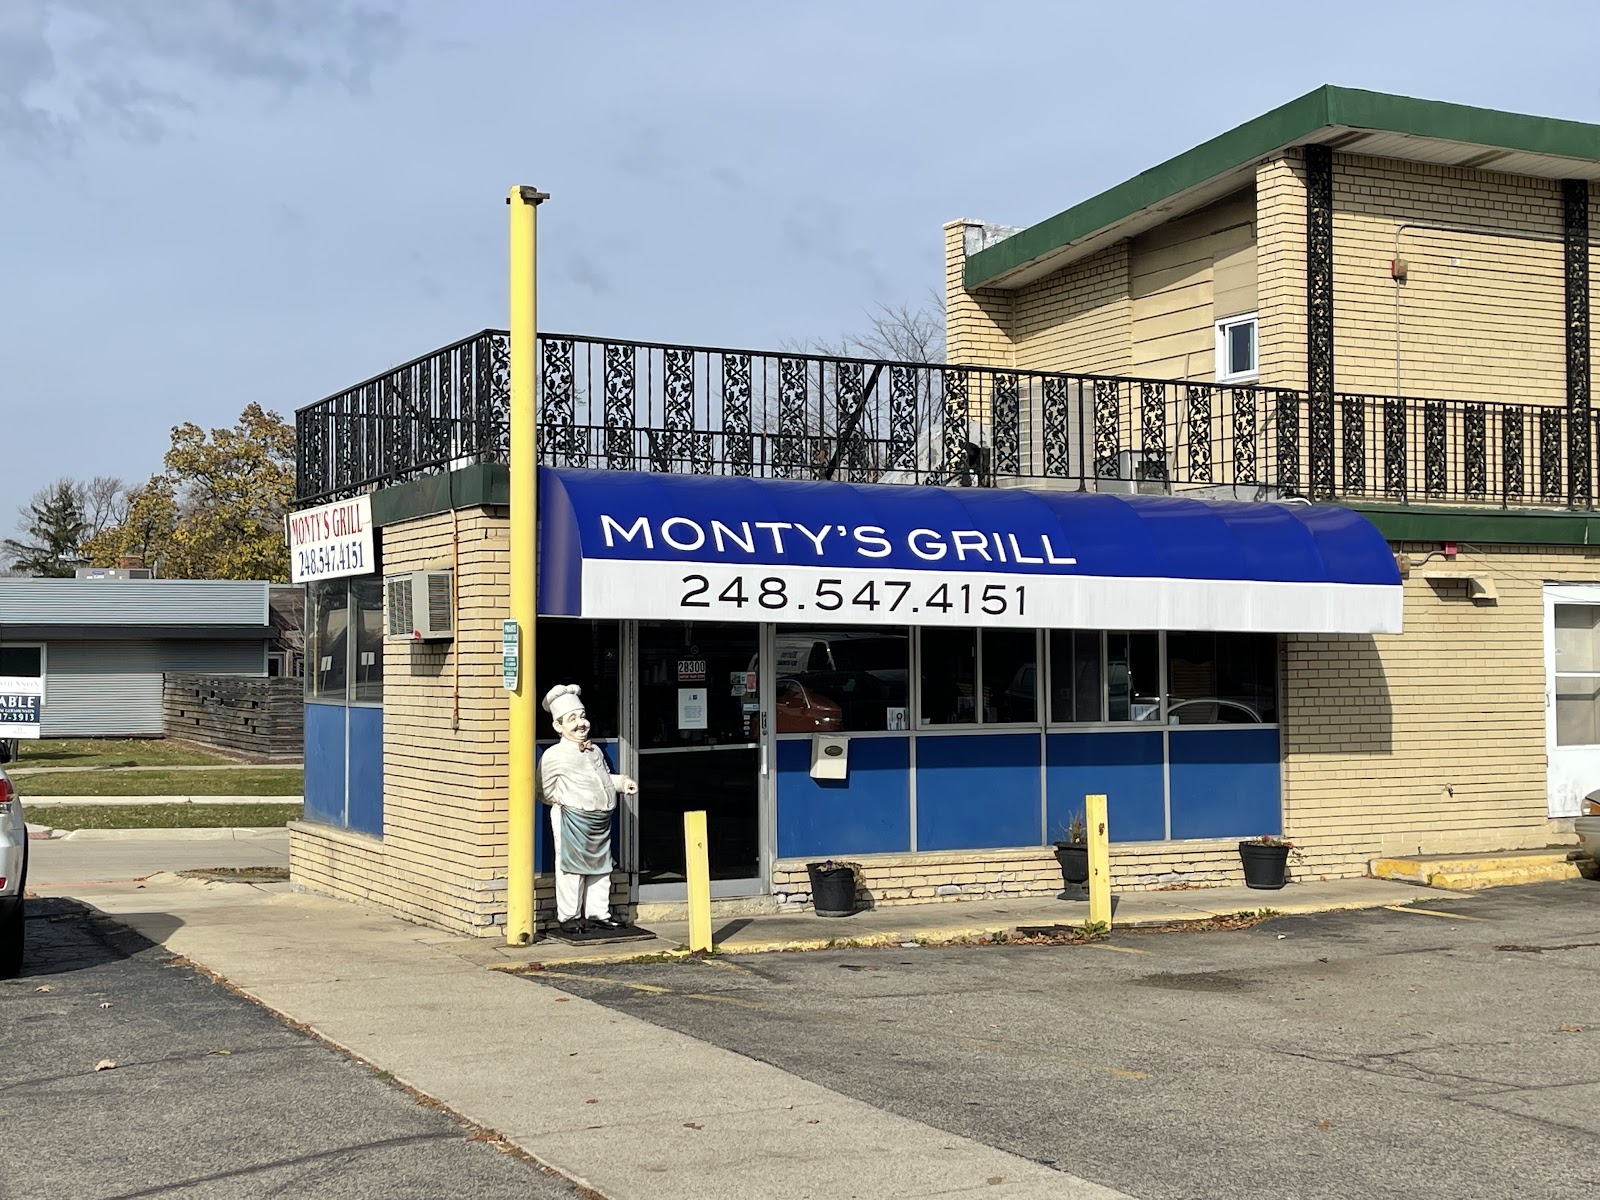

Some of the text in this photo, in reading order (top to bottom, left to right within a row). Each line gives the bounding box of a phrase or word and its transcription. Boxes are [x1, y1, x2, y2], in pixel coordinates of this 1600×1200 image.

[292, 503, 363, 545] MONTY'S GRILL
[600, 514, 1077, 565] MONTY'S GRILL
[298, 540, 365, 577] 248.547.4151
[680, 574, 1026, 617] 248.547.4151
[678, 661, 706, 673] 28300
